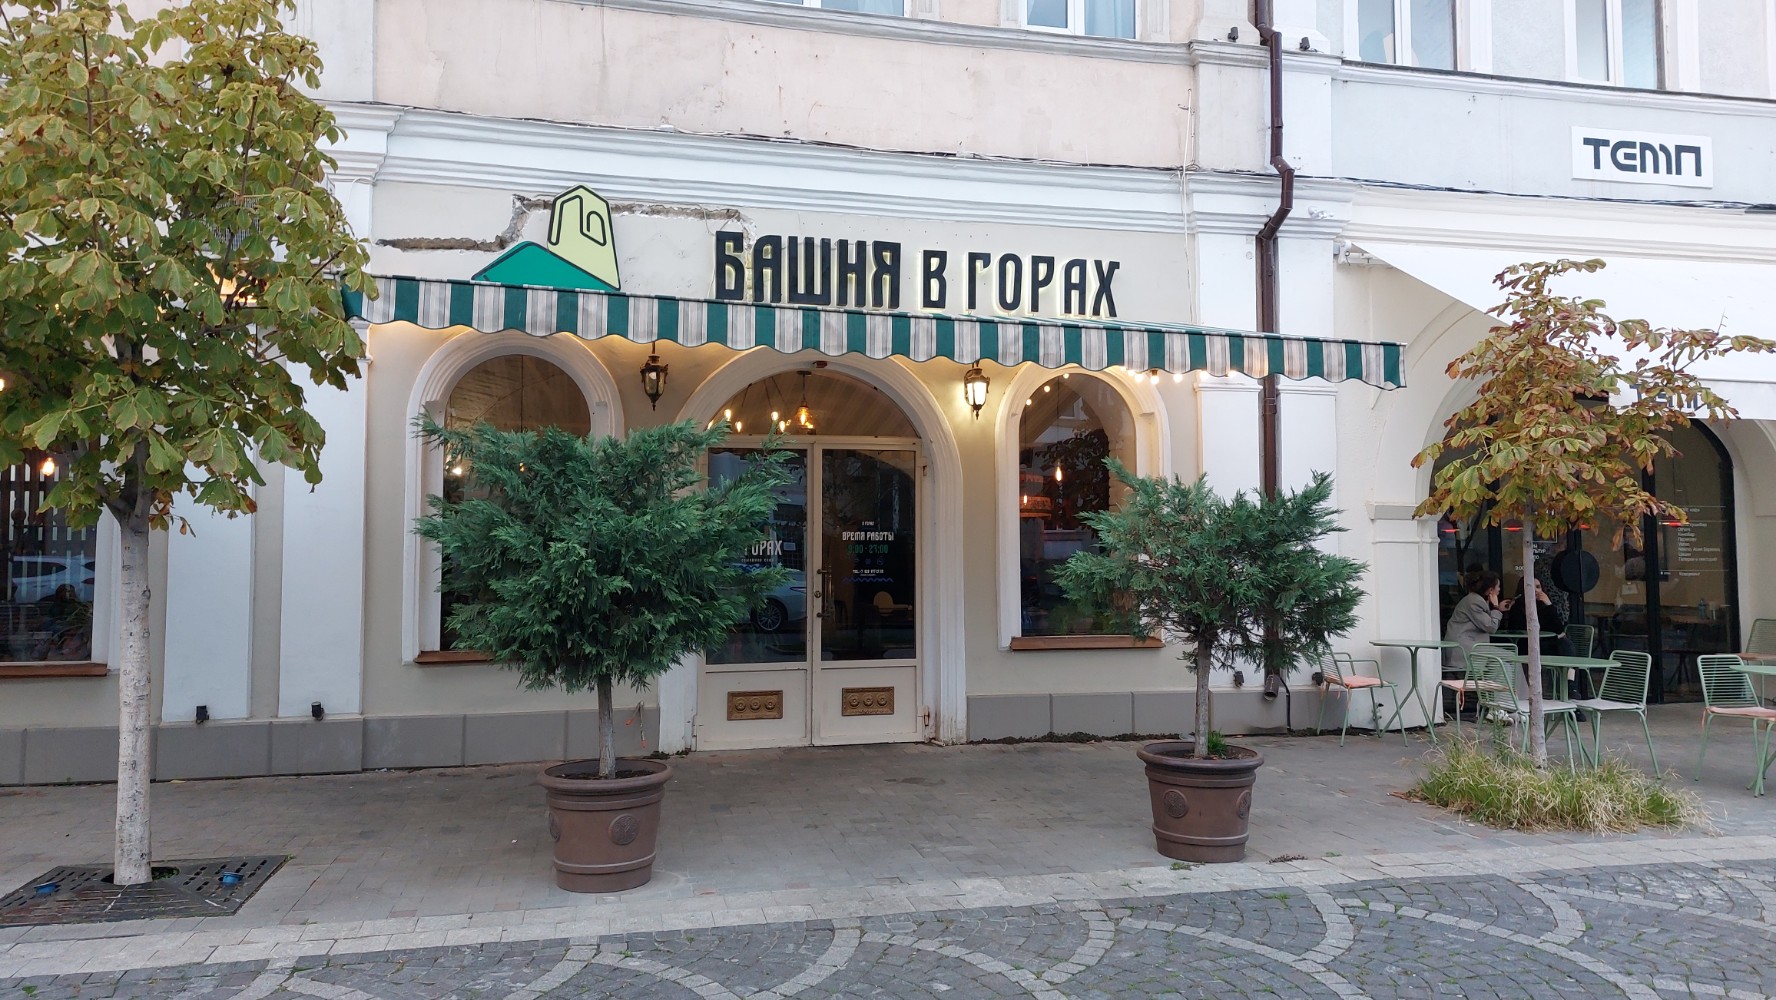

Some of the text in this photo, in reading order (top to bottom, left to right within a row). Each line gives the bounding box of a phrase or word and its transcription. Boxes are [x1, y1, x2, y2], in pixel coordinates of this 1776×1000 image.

[1583, 137, 1702, 177] ТЕМП
[716, 231, 1120, 317] БАШНЯ В ГОРАХ
[842, 531, 895, 541] ВРЕМЯ РАБОТЫ
